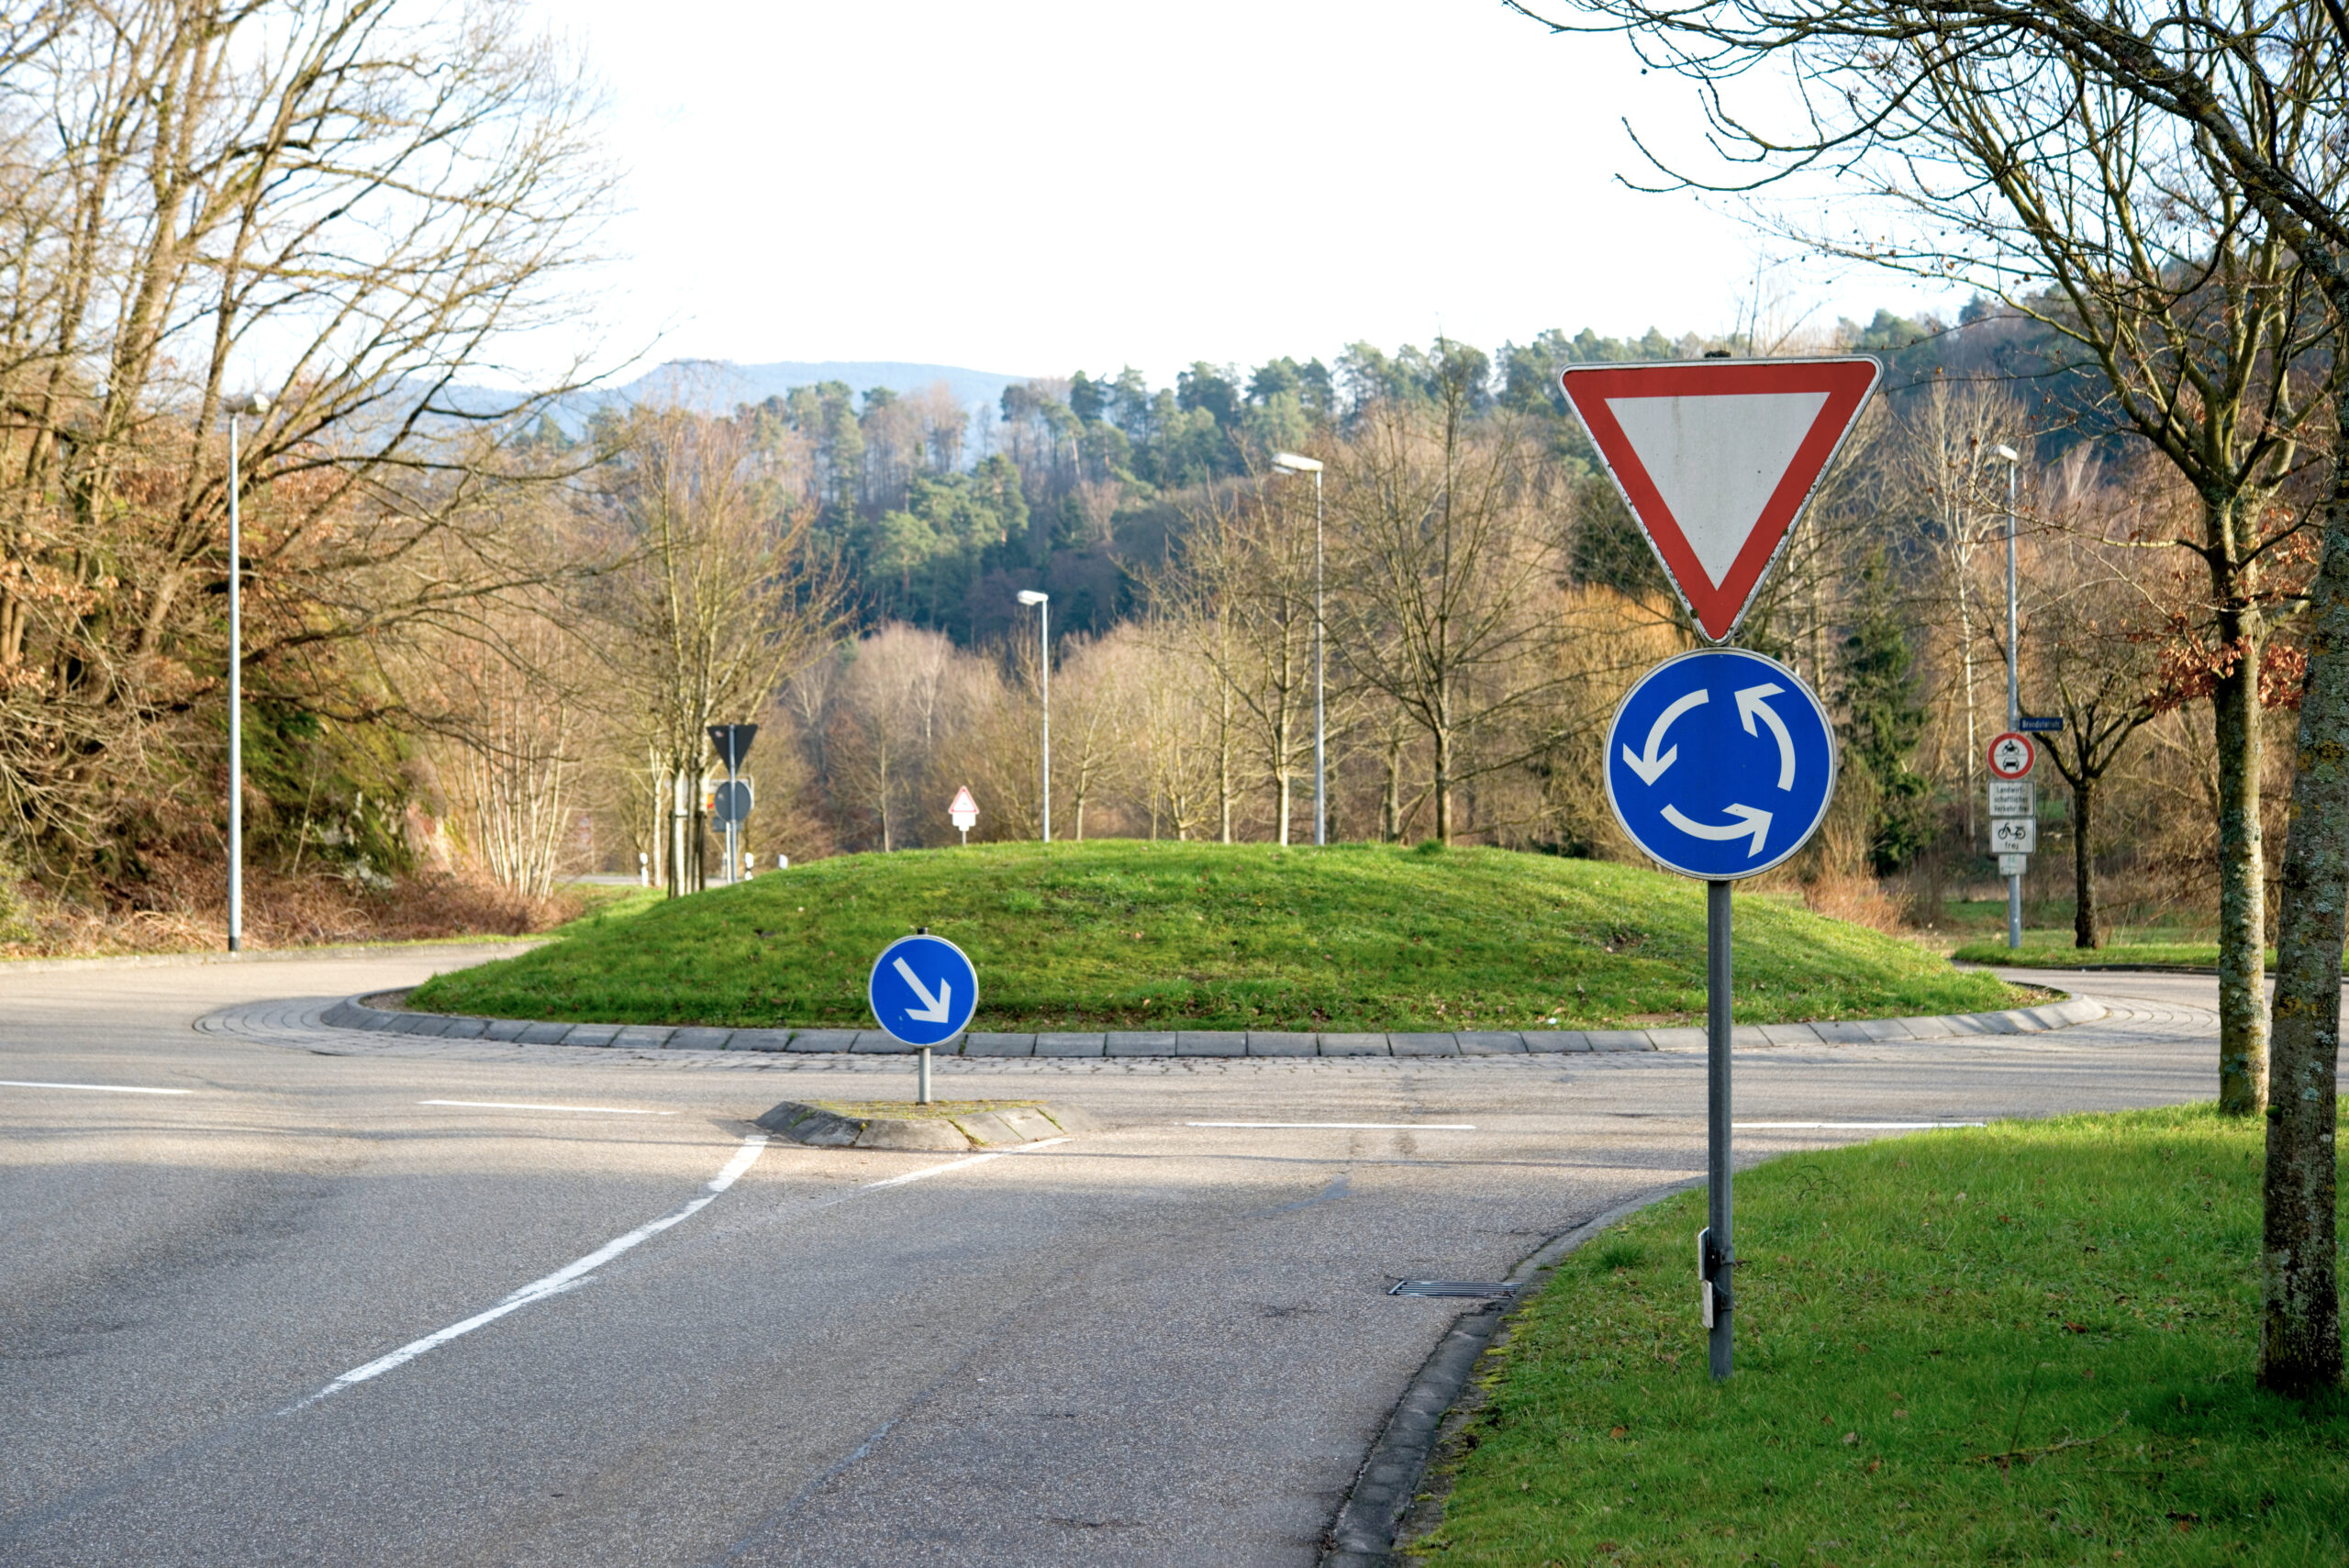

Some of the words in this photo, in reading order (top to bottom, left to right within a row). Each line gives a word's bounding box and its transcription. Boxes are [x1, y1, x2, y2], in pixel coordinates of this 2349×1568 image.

[1994, 805, 2016, 813] Verkehr
[2019, 805, 2030, 813] frei
[2005, 841, 2019, 851] frei
